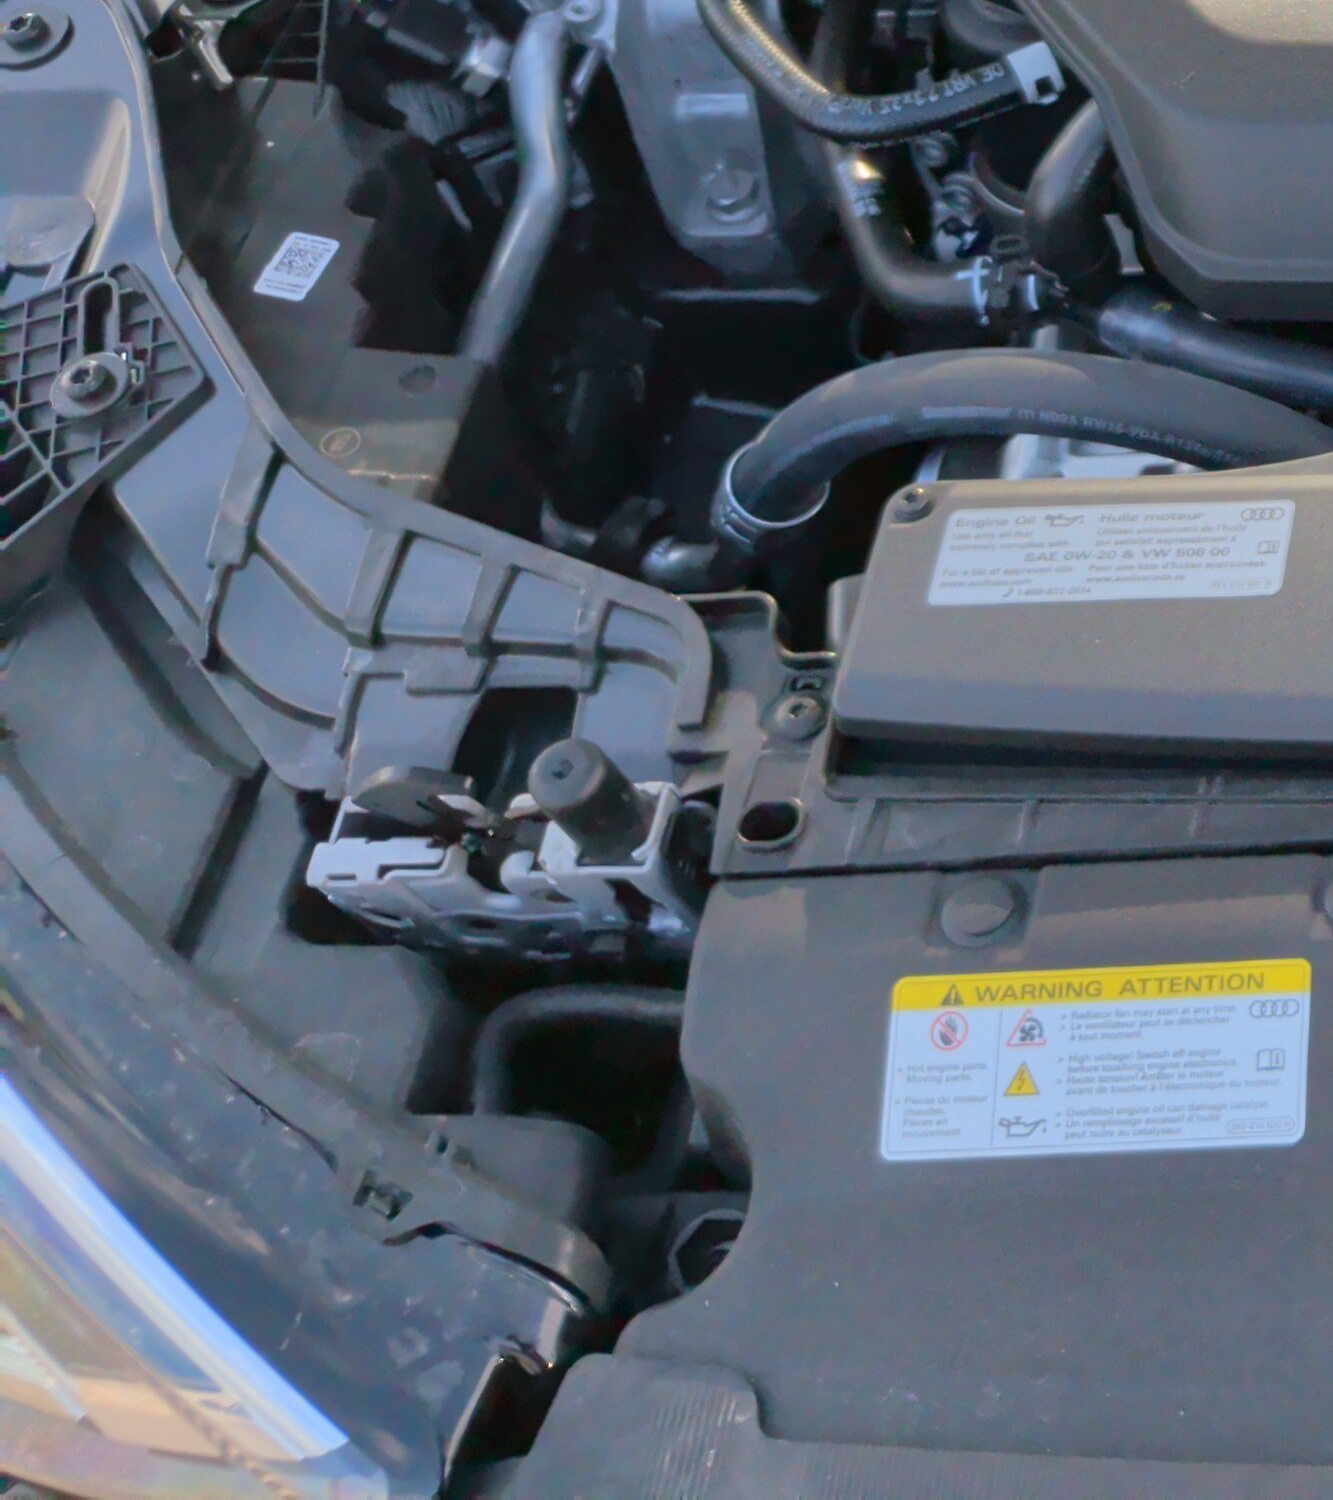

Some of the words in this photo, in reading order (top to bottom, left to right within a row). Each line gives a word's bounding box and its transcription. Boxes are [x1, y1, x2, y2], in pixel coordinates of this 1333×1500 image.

[955, 517, 1009, 529] Engine
[1014, 515, 1036, 525] Oil
[1100, 512, 1139, 523] Huile
[1144, 511, 1205, 521] moteur
[1024, 550, 1058, 561] SAE
[1063, 549, 1117, 560] 0W-20
[1122, 549, 1135, 559] &
[1142, 548, 1170, 558] VW
[1176, 547, 1205, 557] 508
[1210, 546, 1230, 556] 00
[975, 980, 1103, 1003] WARNING
[1119, 972, 1265, 996] ATTENTION
[1188, 1047, 1221, 1058] engine
[926, 1063, 960, 1074] engine
[1067, 1064, 1099, 1074] before
[1101, 1062, 1144, 1073] touching
[1146, 1061, 1181, 1071] engine
[906, 1074, 943, 1085] Moving
[1116, 1105, 1150, 1116] engine
